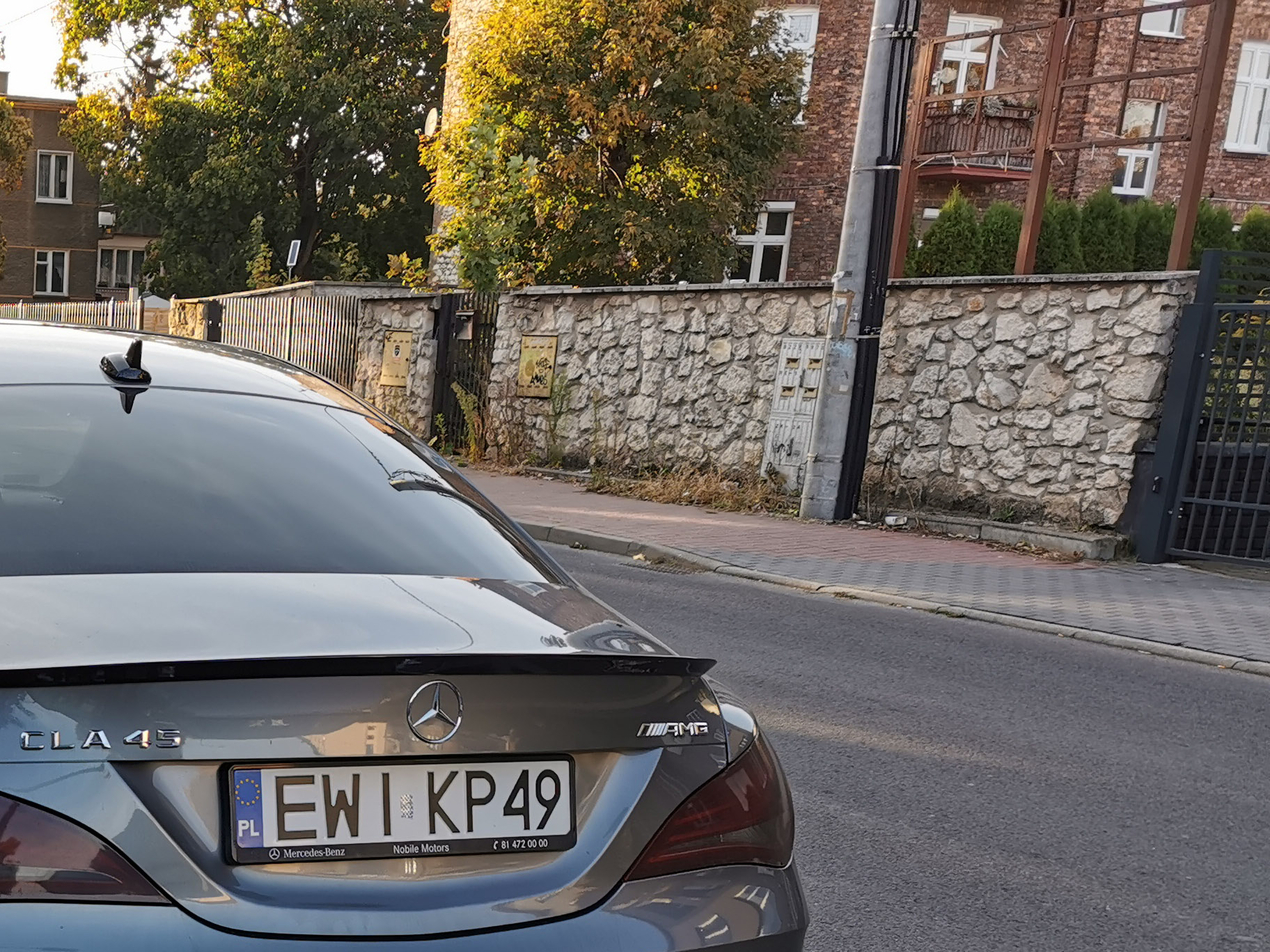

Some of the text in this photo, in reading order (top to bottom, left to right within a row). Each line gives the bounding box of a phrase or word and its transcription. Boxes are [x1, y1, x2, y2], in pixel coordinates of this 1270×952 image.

[20, 729, 182, 750] CLA 45
[275, 769, 562, 841] EWI KP49
[238, 819, 260, 838] PL
[393, 843, 450, 854] Nobile Motors
[501, 838, 548, 849] 81 472 00 00
[283, 848, 346, 859] Mercedes-Benz
